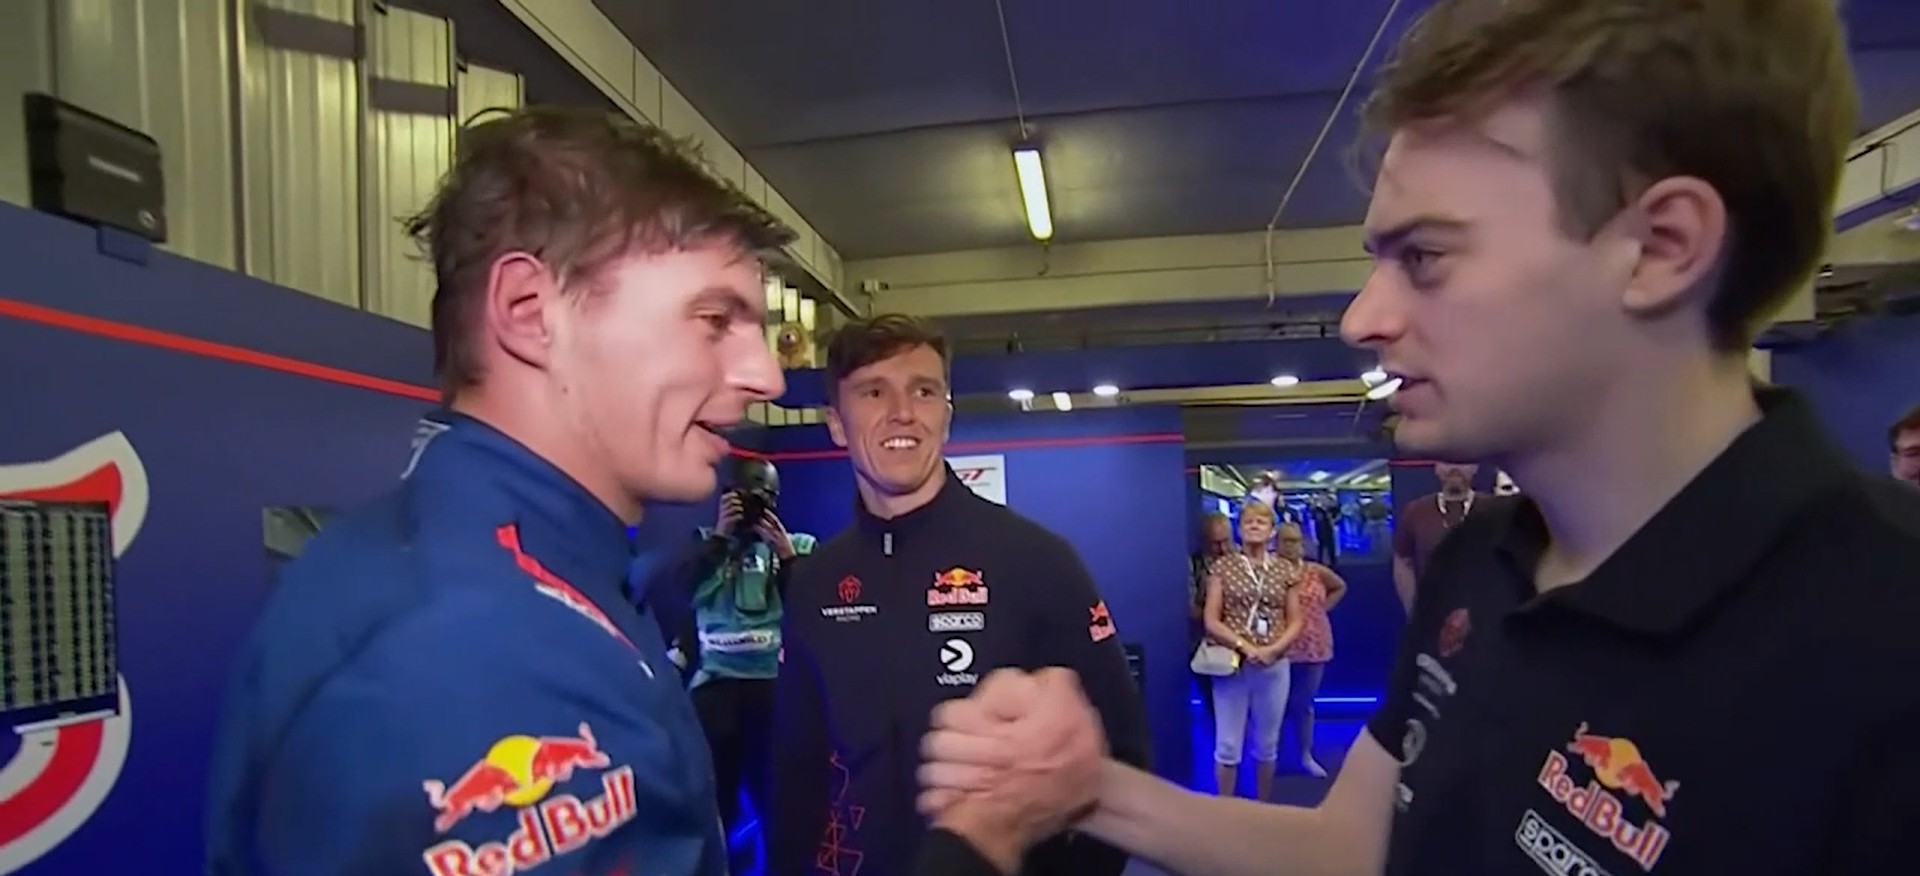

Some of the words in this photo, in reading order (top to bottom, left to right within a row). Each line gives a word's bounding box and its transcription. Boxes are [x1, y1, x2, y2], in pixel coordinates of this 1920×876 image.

[538, 764, 637, 854] Bull
[1537, 749, 1602, 823] Red
[1584, 786, 1671, 872] Bull
